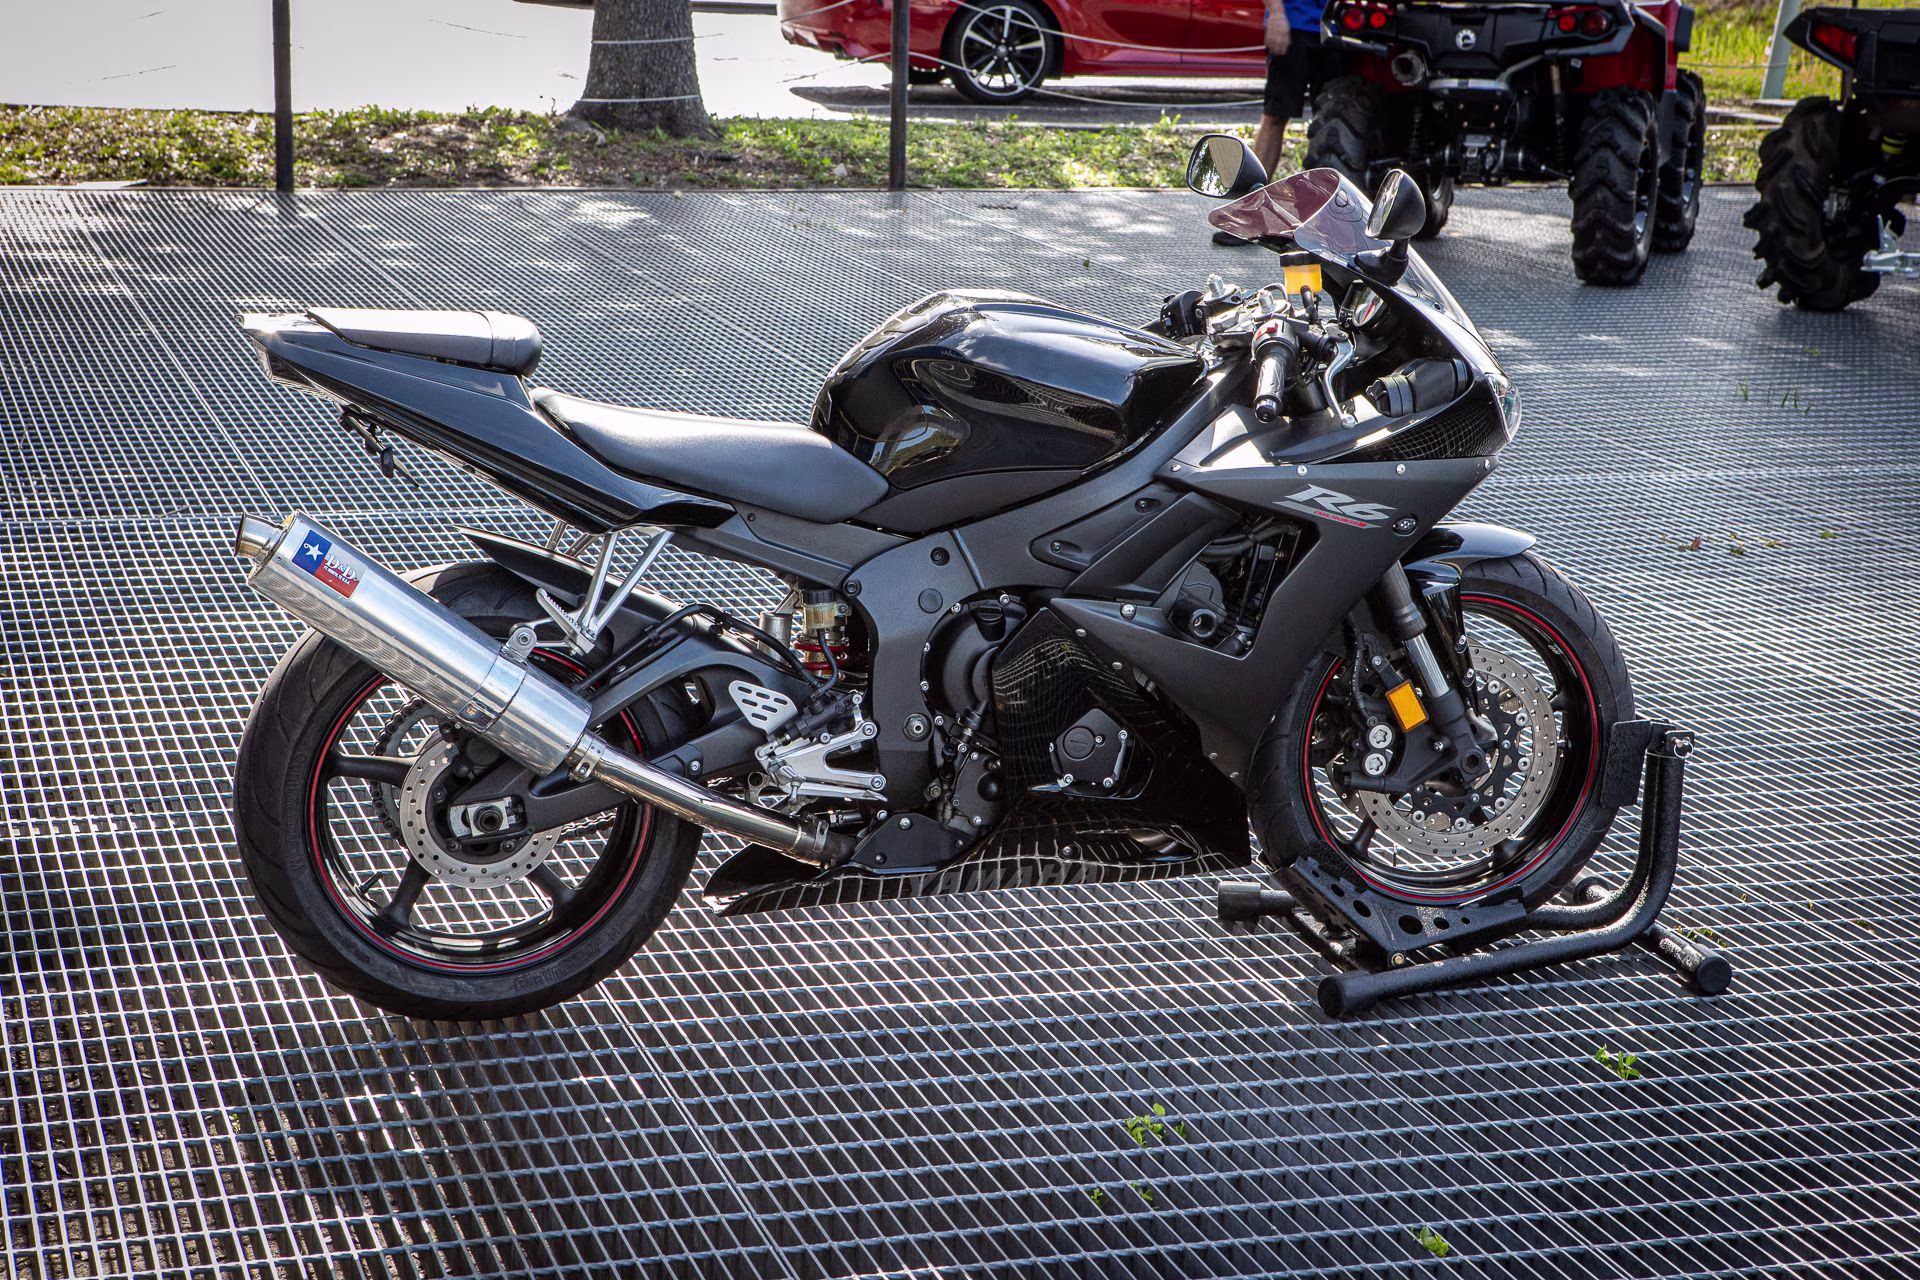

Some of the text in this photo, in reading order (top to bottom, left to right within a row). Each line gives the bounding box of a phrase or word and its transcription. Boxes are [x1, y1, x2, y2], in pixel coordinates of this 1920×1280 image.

[1284, 483, 1396, 520] R6
[325, 555, 357, 580] D&D
[907, 863, 1099, 896] YAMAHA
